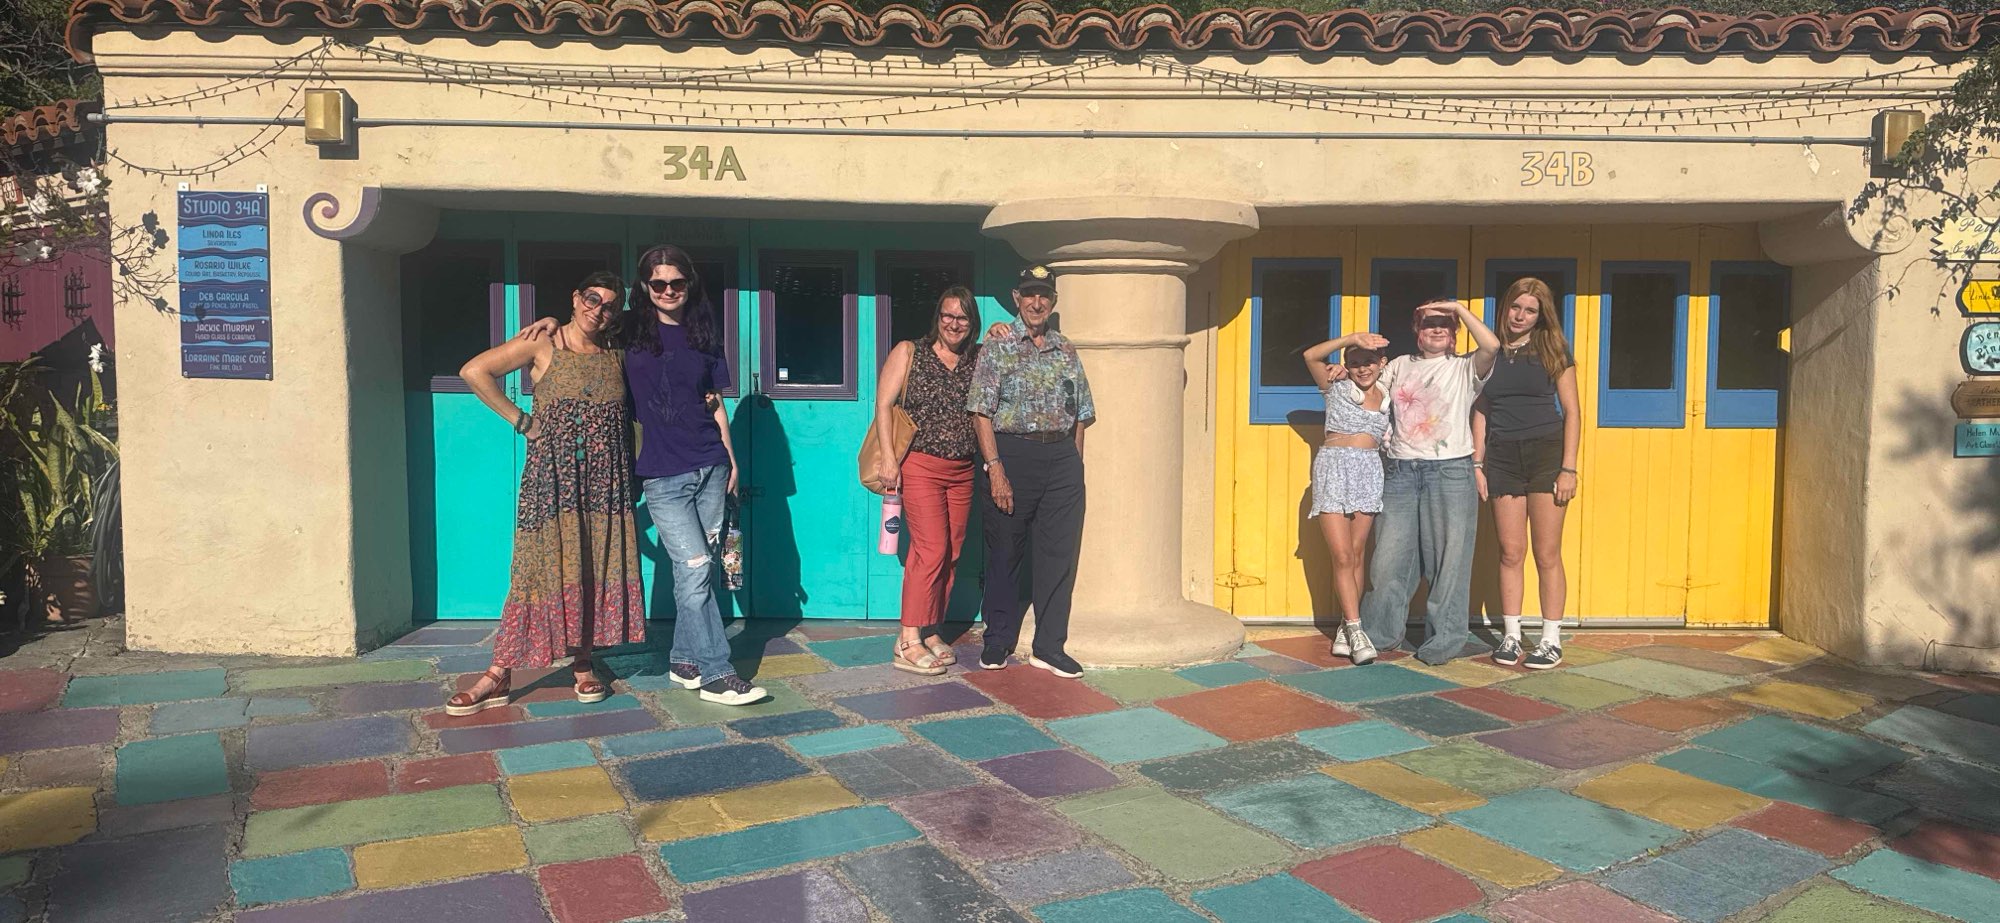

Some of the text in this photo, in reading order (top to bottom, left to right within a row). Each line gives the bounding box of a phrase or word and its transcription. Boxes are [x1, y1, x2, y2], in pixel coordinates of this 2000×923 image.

[663, 145, 747, 181] 34A
[1520, 151, 1595, 187] 34B
[183, 198, 261, 215] STUDIO 34A
[202, 229, 242, 239] LINDA ILES
[194, 261, 252, 271] ROSARIO WILKE
[199, 292, 214, 301] DEB
[195, 323, 255, 332] JACKIE MURPHY
[184, 353, 220, 363] LORRAINE
[222, 354, 247, 363] MARIE
[1966, 427, 1986, 437] Helen
